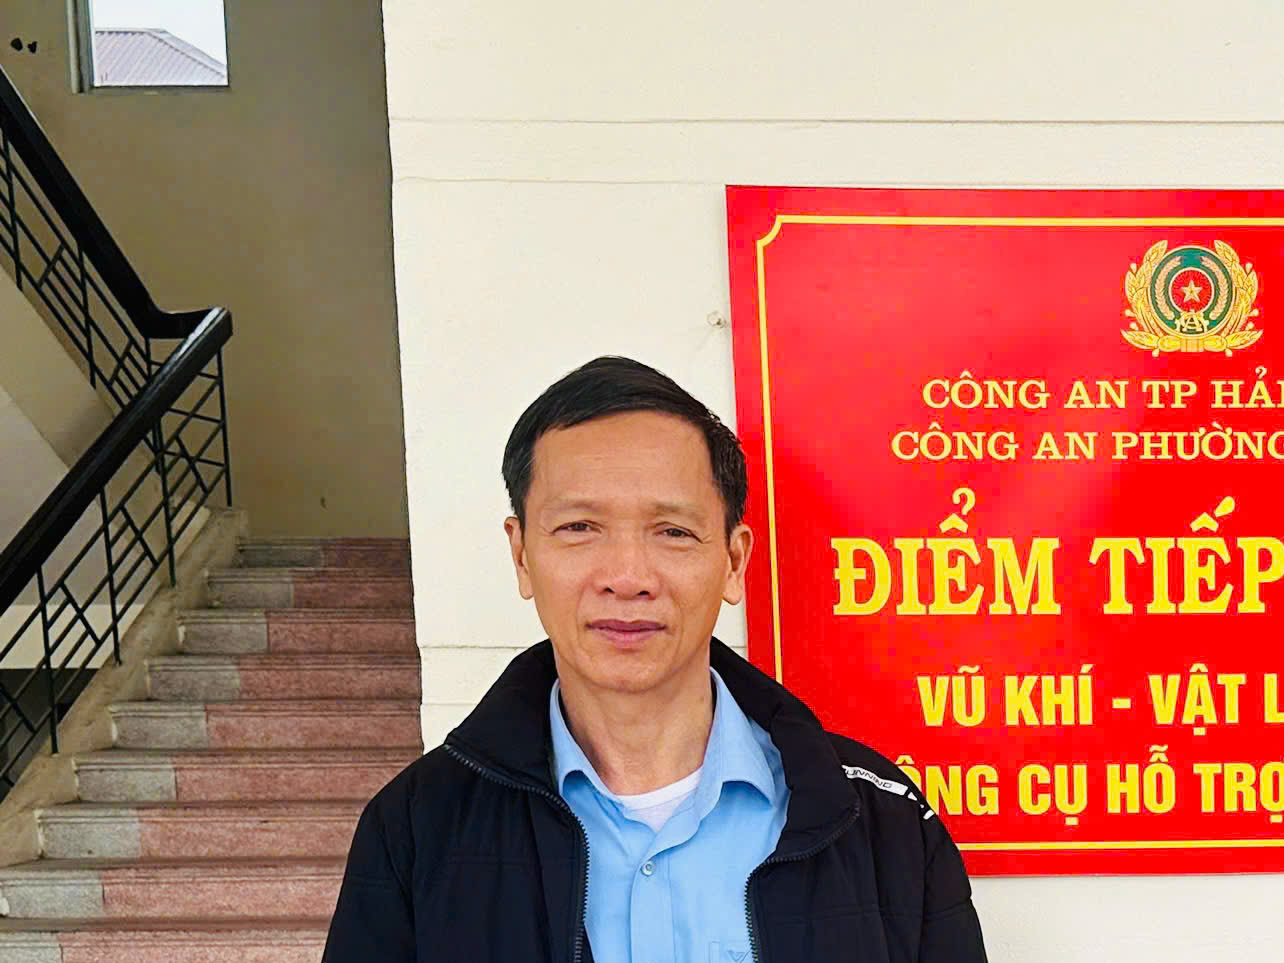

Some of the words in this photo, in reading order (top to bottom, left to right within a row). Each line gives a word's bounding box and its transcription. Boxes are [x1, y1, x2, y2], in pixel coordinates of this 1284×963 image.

[922, 369, 1051, 410] CÔNG
[1064, 379, 1130, 409] AN
[1141, 380, 1198, 409] TP
[891, 421, 1020, 461] CÔNG
[1031, 431, 1099, 461] AN
[830, 487, 1062, 617] ĐIỂM
[916, 665, 986, 727] VŨ
[1004, 663, 1094, 727] KHÍ
[1111, 696, 1132, 710] -
[1147, 662, 1247, 737] VẬT
[843, 766, 893, 790] UNNING
[1017, 764, 1088, 826] CỤ
[1106, 744, 1177, 814] HỖ
